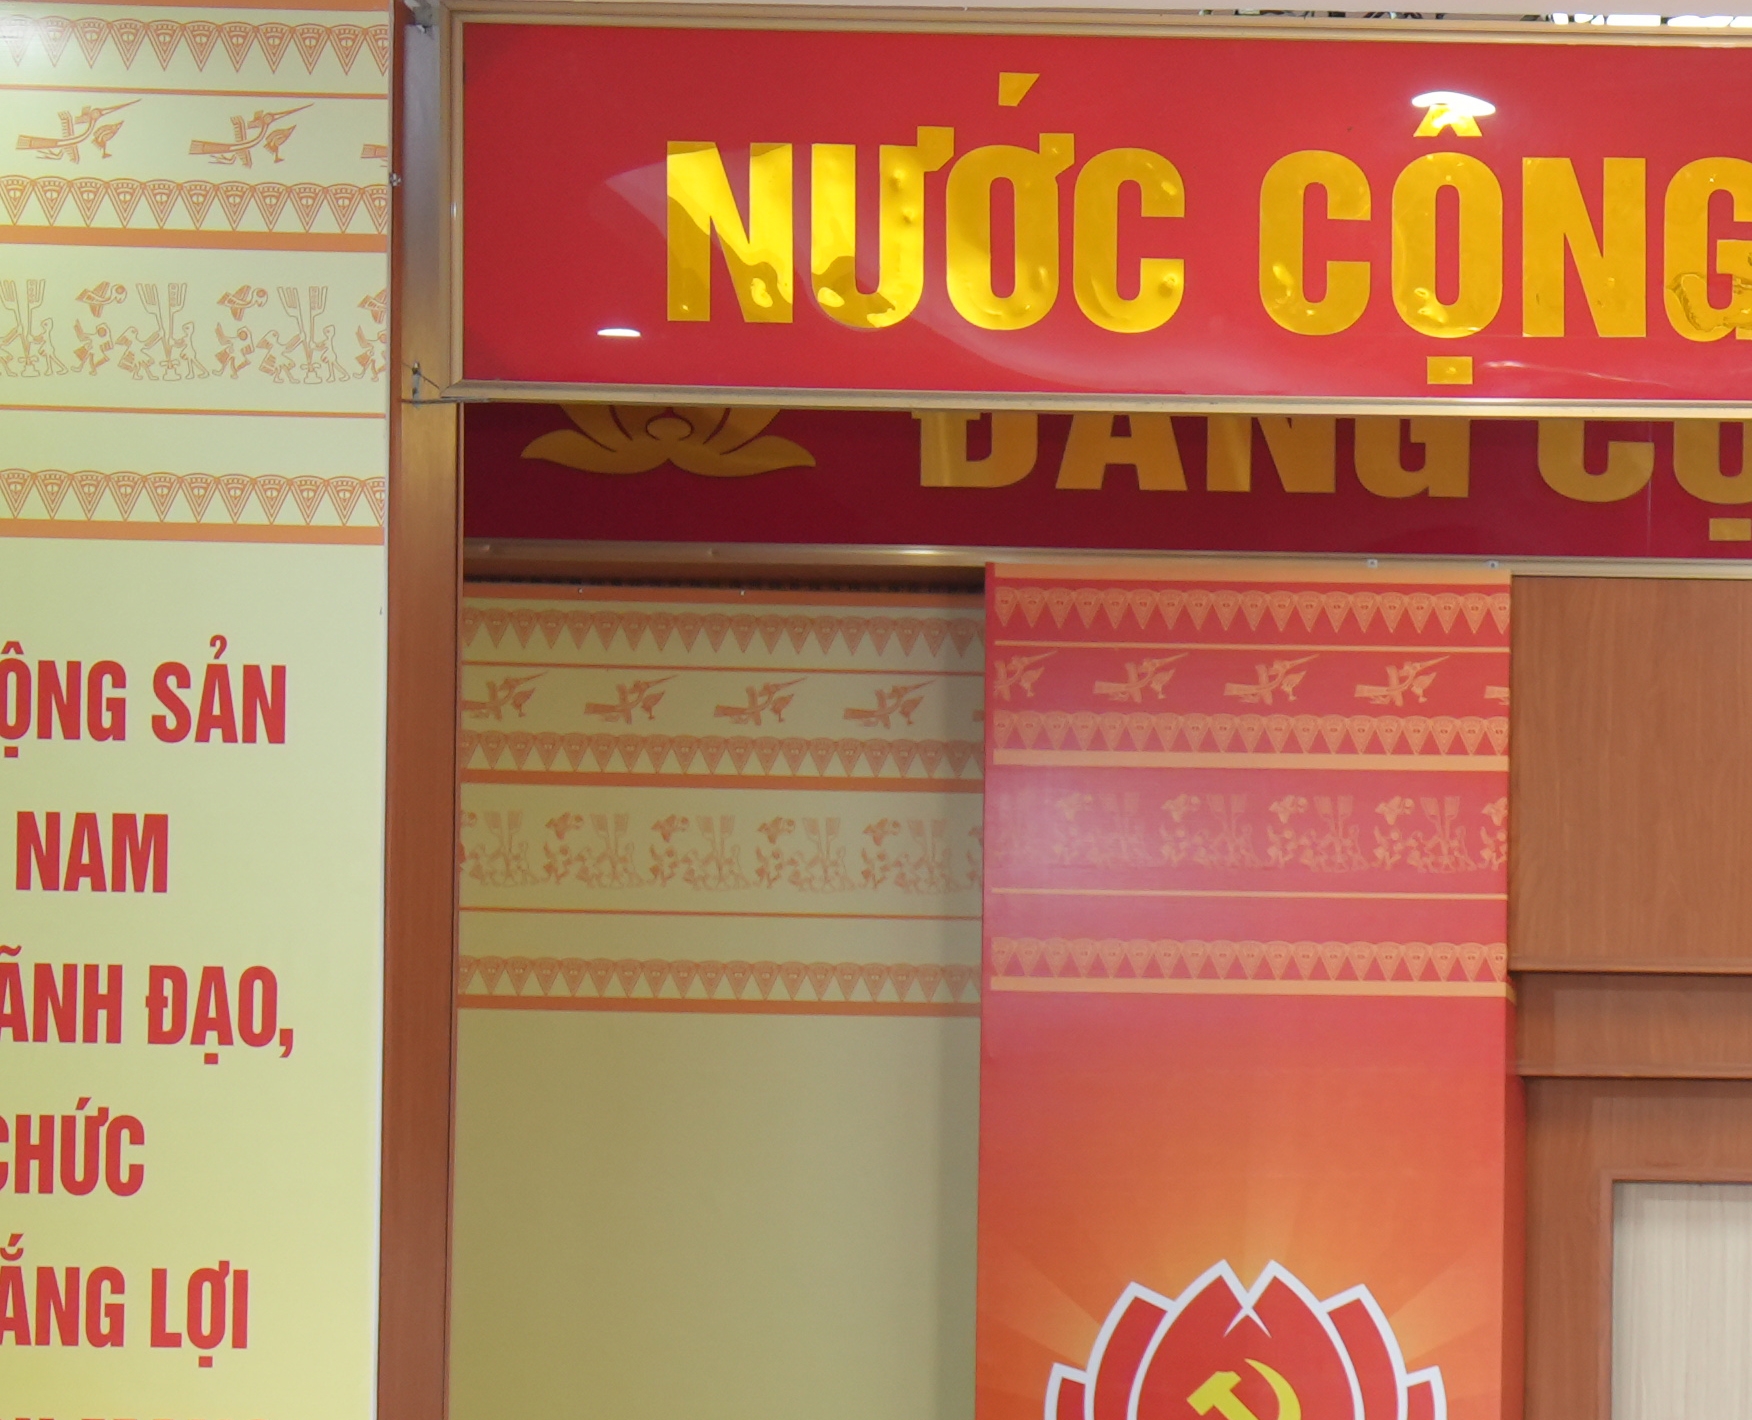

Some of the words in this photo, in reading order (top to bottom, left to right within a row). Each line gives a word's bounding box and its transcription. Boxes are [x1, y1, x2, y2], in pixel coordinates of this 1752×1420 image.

[666, 73, 1185, 333] NƯỚC
[151, 634, 287, 745] SẢN
[16, 811, 169, 893] NAM
[145, 964, 294, 1065] ĐẠO,
[0, 1096, 146, 1197] HỨC
[150, 1260, 249, 1368] LỢI
